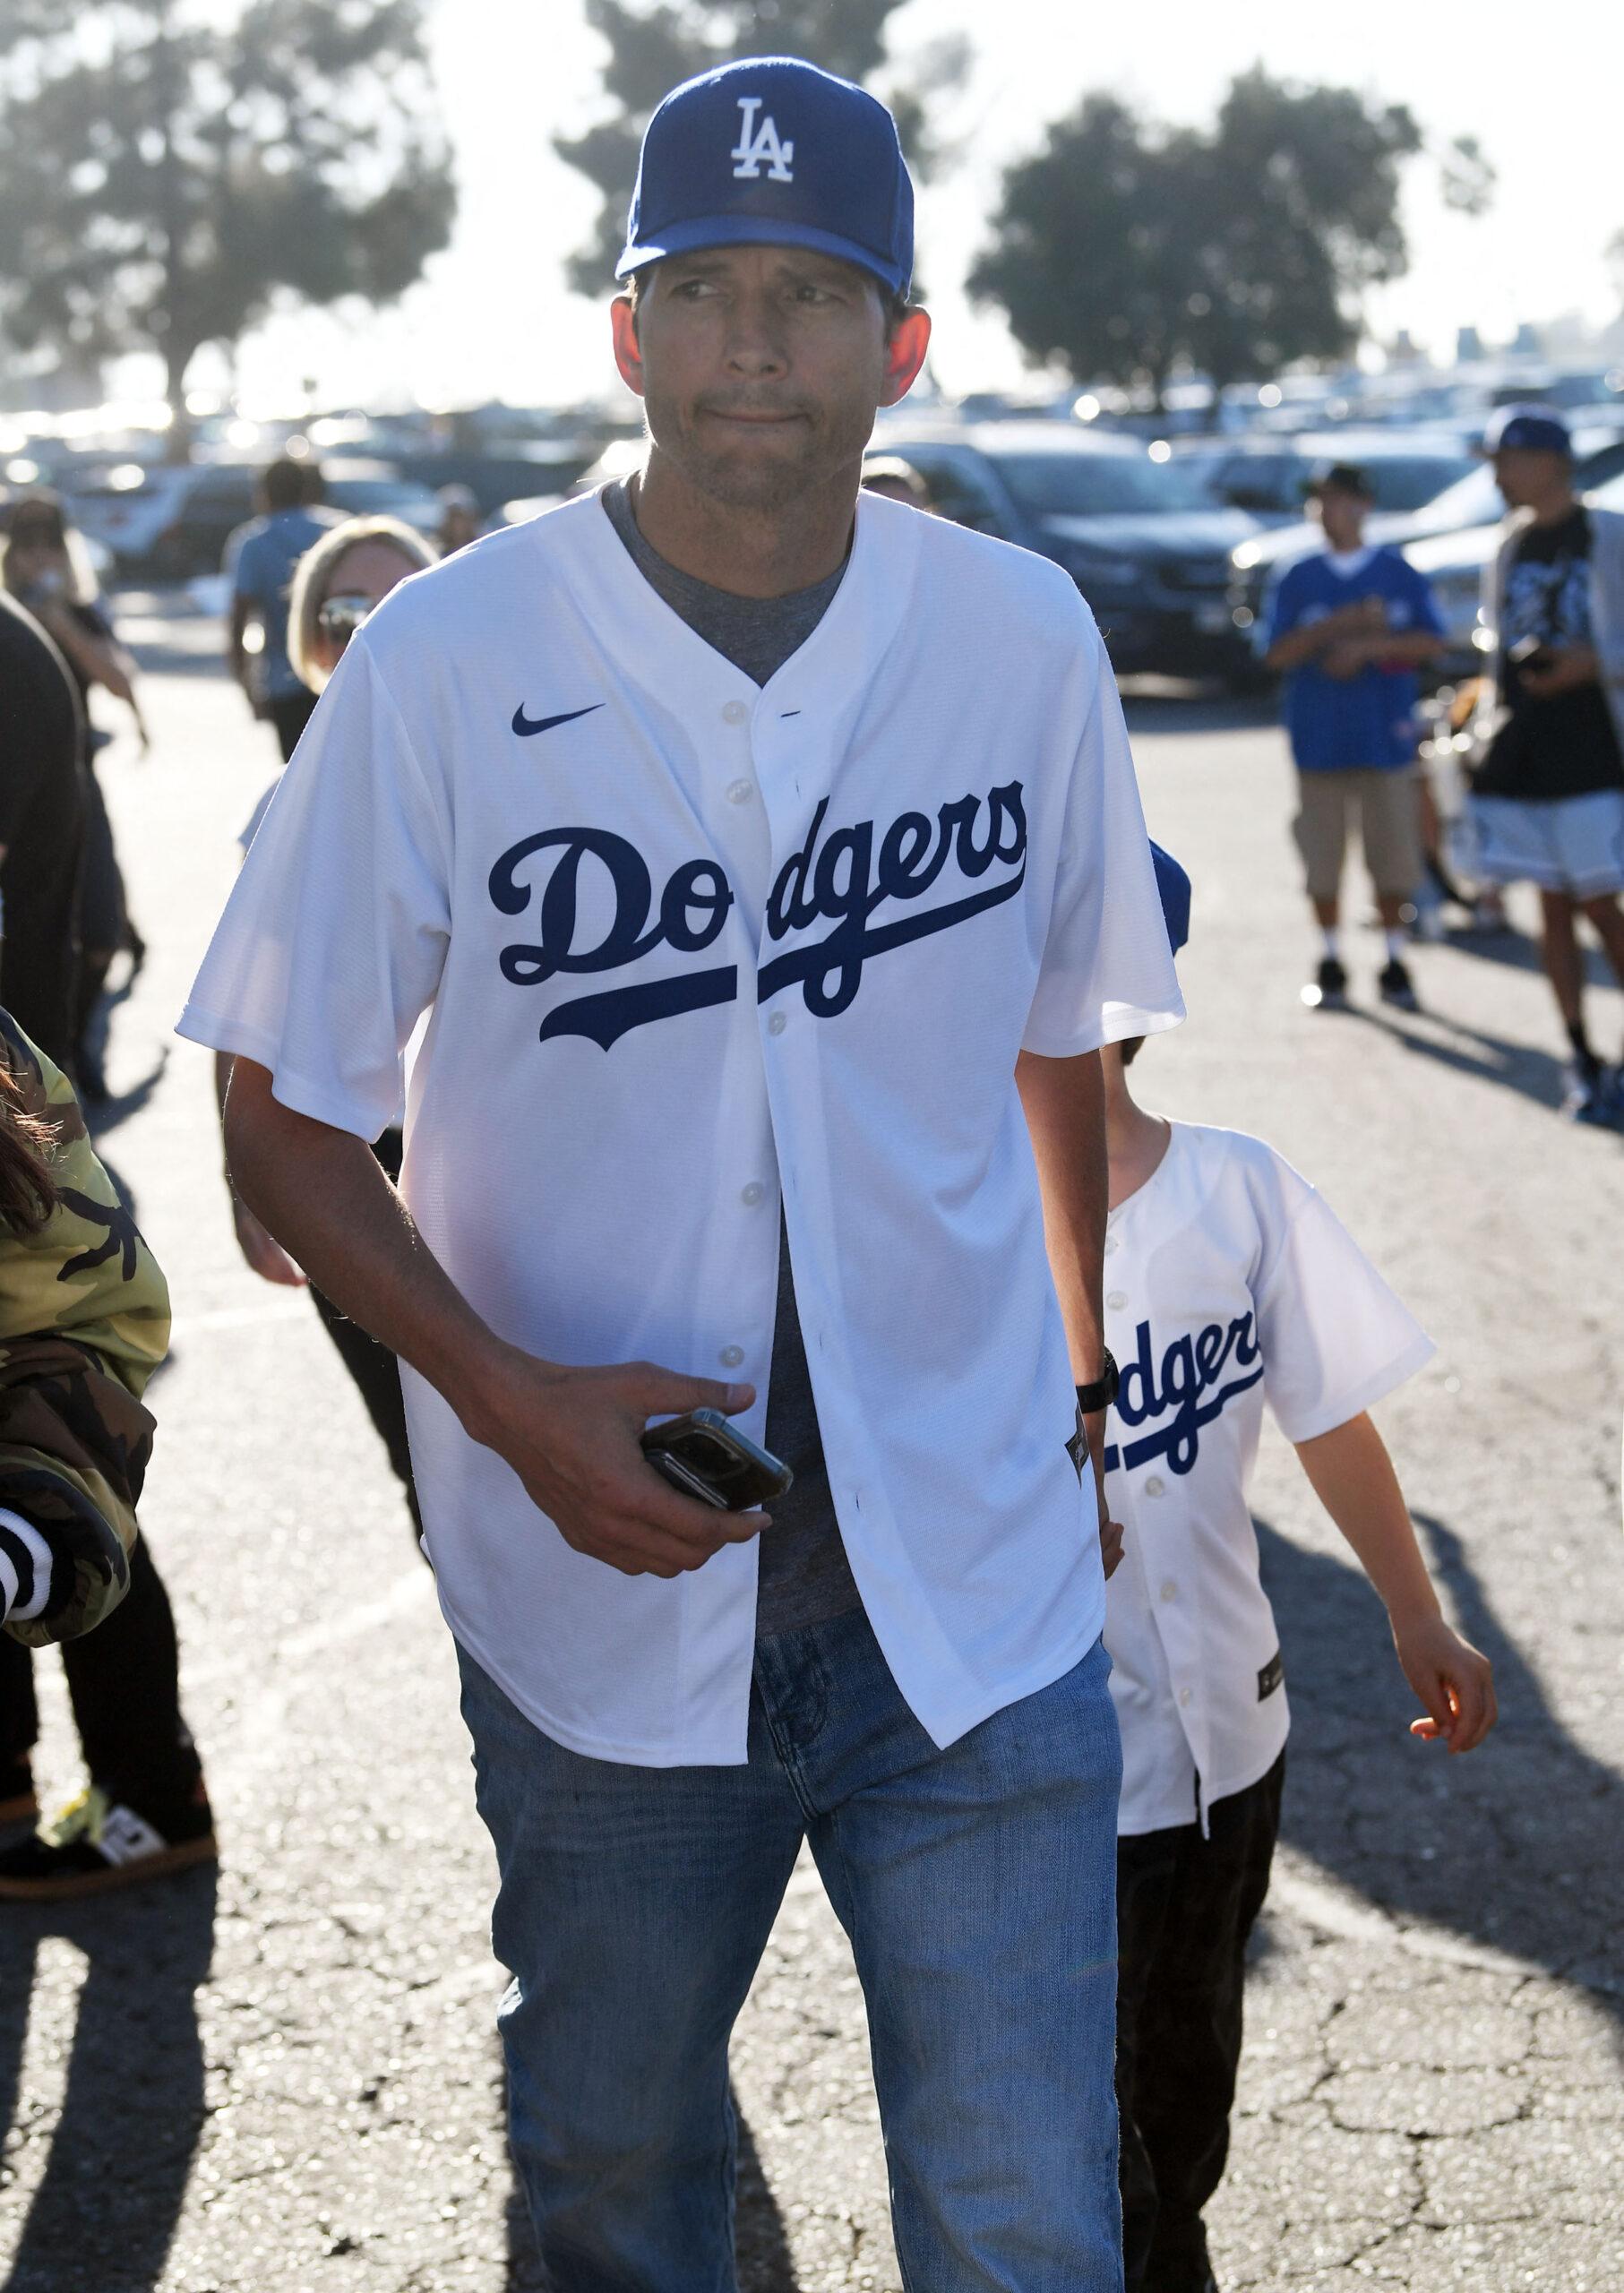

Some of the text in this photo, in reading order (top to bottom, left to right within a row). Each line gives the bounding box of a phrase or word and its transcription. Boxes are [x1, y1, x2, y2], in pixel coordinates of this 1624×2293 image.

[731, 98, 794, 183] LA
[488, 780, 1028, 1019] Dodgers
[1113, 1310, 1262, 1475] dger
